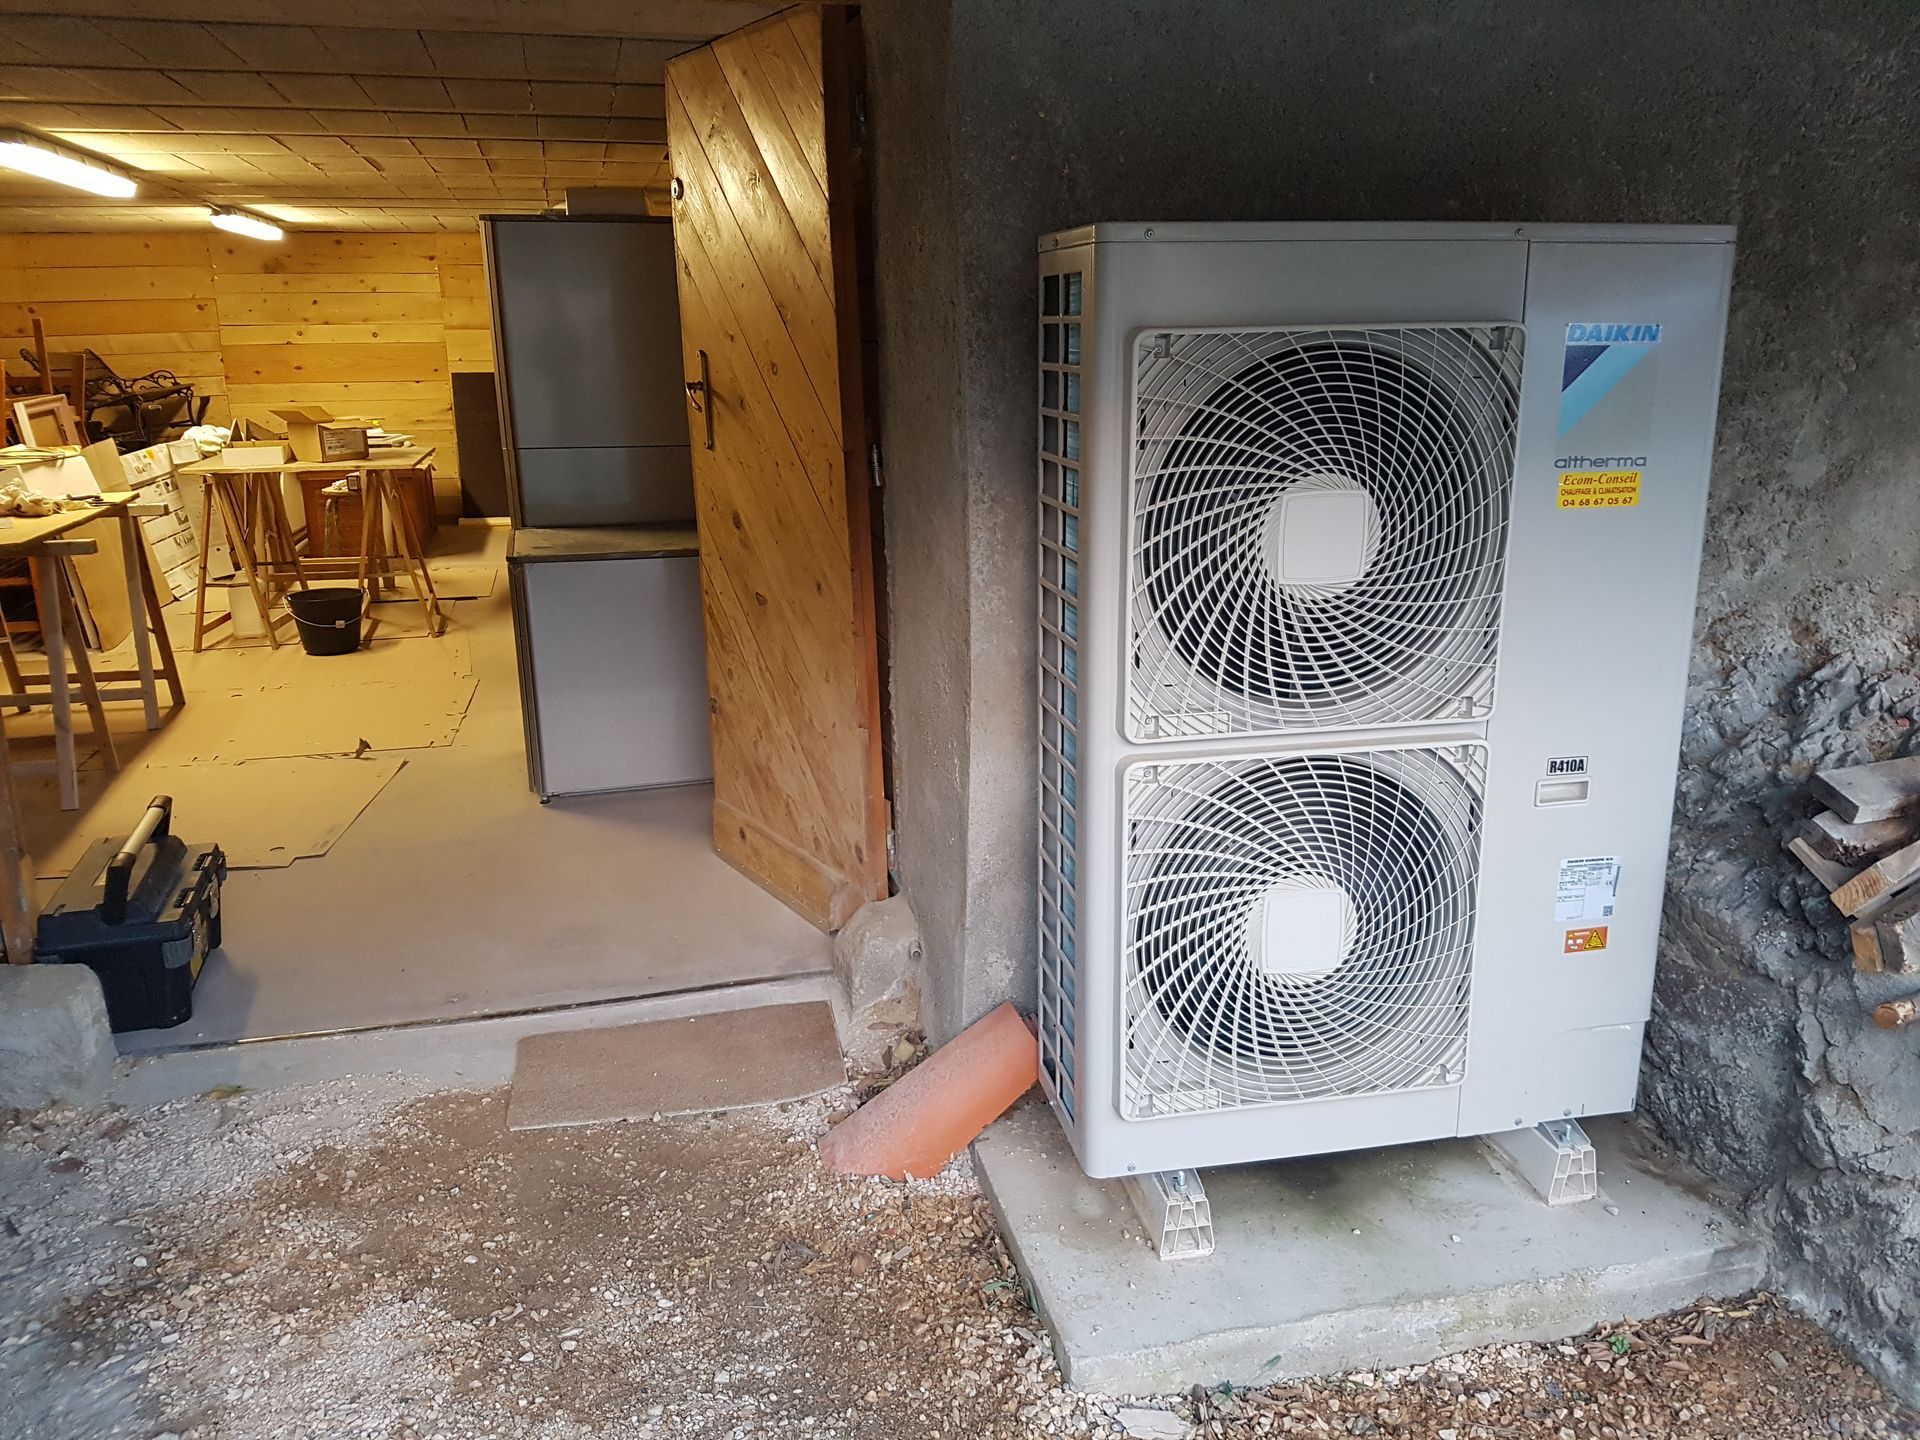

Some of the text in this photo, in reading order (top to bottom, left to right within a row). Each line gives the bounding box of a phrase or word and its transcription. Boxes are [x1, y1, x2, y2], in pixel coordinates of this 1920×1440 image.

[1567, 324, 1660, 342] DAIKIN
[1554, 456, 1647, 469] altherma
[1563, 472, 1638, 486] Ecom-Conseil
[1560, 488, 1592, 496] CHAUFFAGE
[1598, 486, 1637, 494] CLIMATISATION
[1562, 499, 1575, 507] 04
[1593, 498, 1604, 506] 67
[1607, 497, 1619, 505] 05
[1622, 496, 1633, 505] 67
[1550, 758, 1585, 774] R410A
